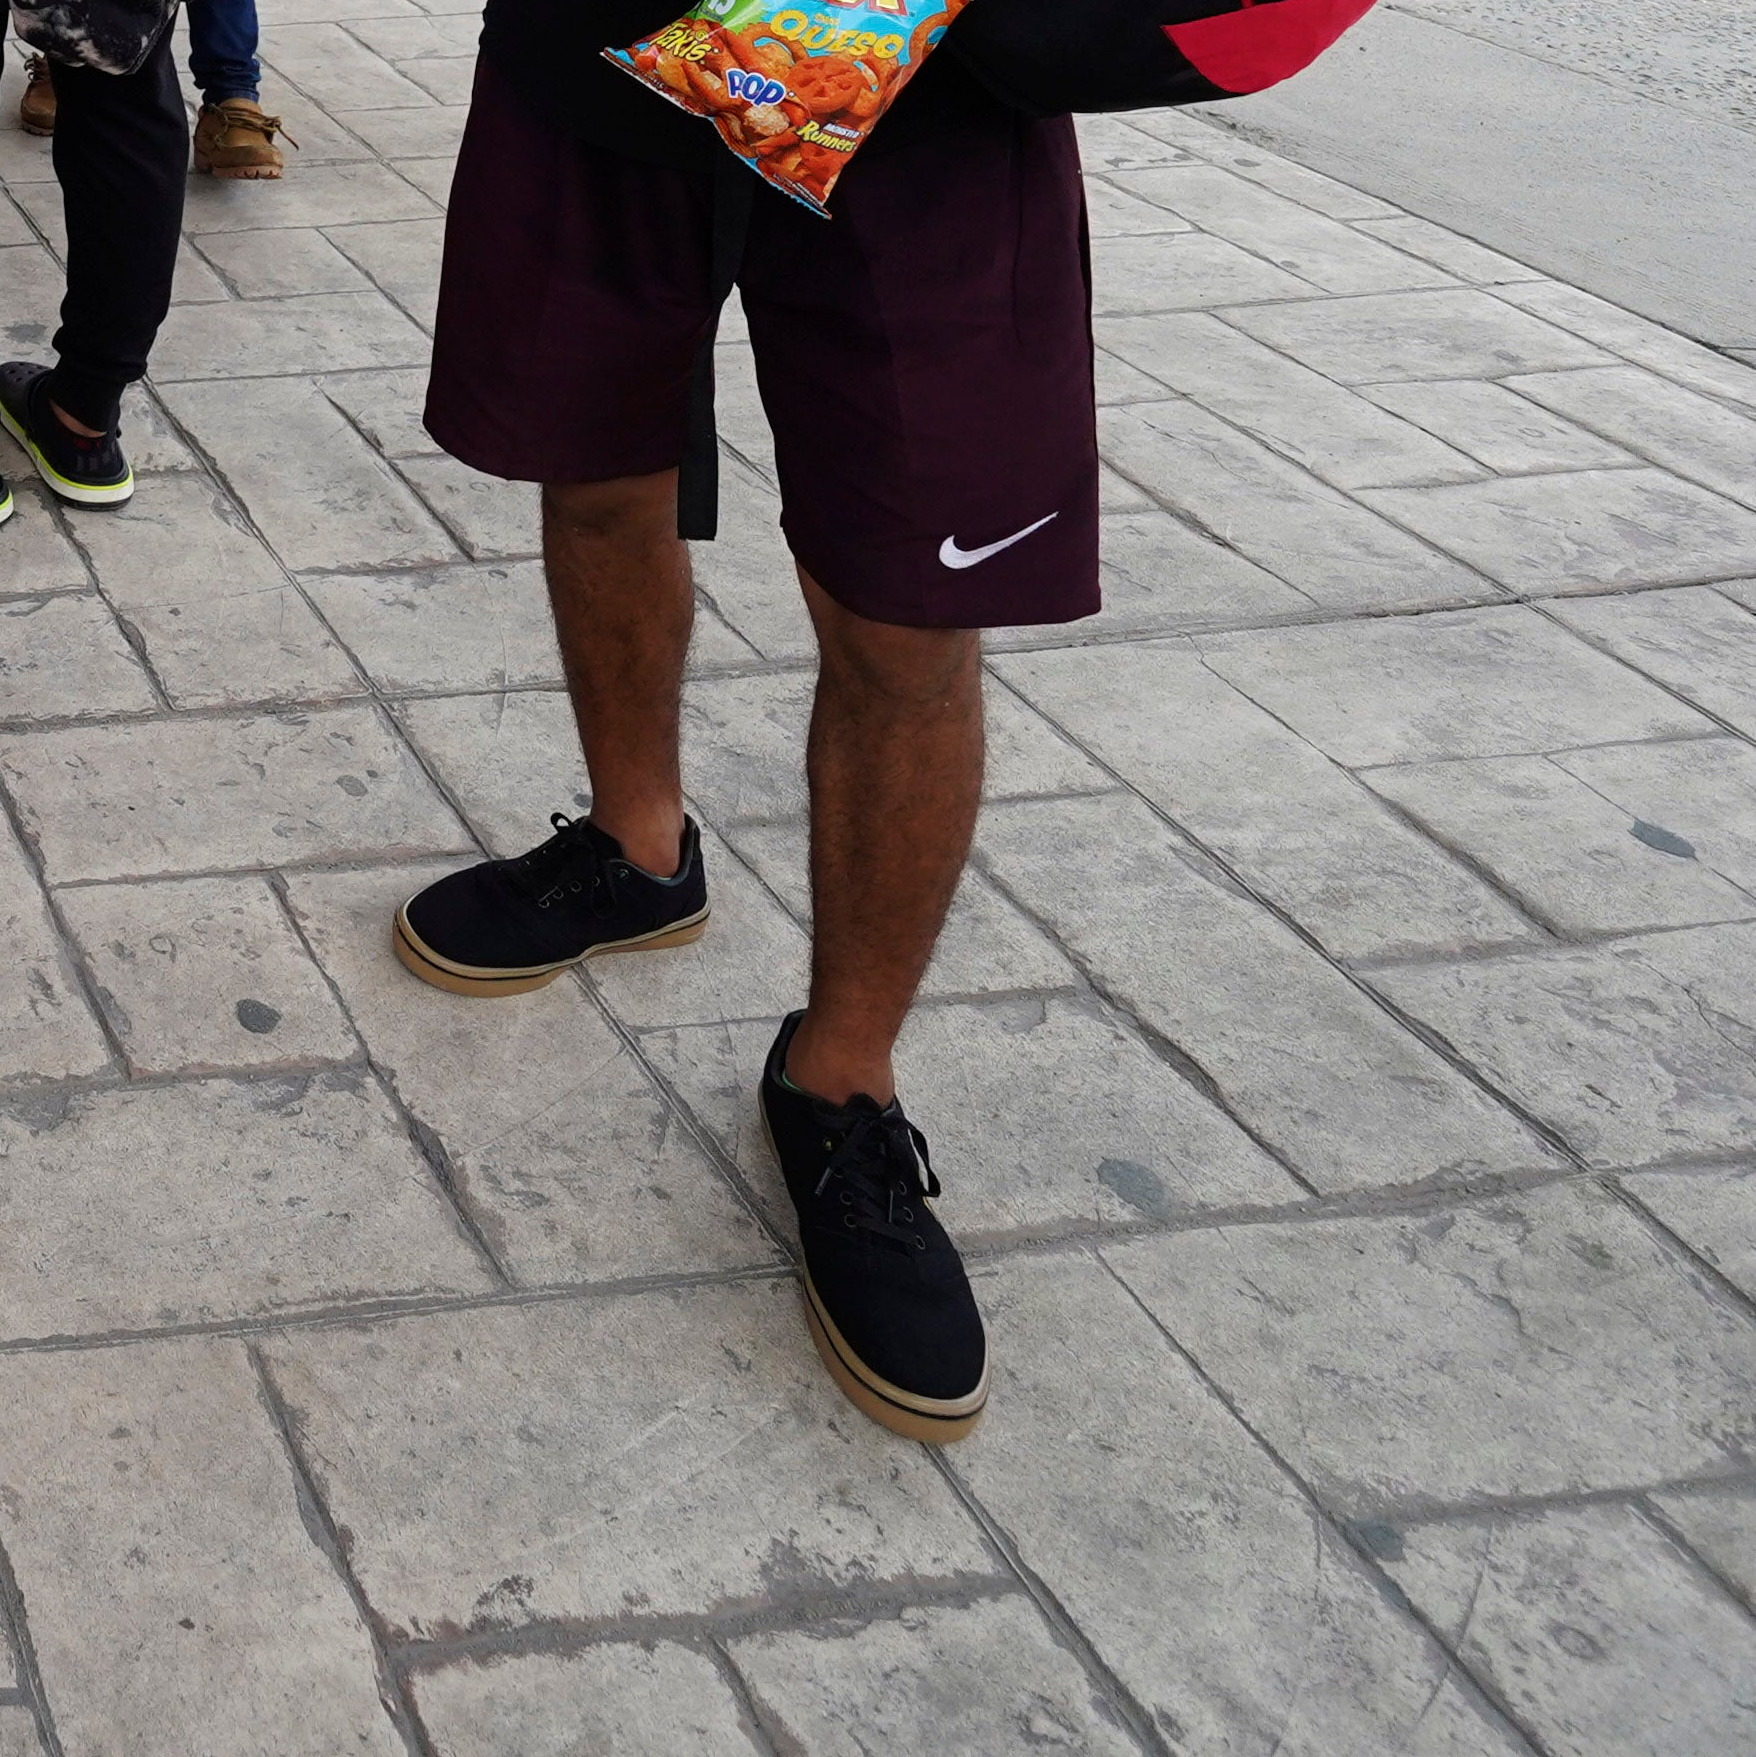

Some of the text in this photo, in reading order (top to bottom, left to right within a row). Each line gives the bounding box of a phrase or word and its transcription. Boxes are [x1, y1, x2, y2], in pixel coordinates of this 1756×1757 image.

[770, 9, 905, 59] QUESO
[726, 68, 787, 106] POP
[796, 120, 857, 152] Runners
